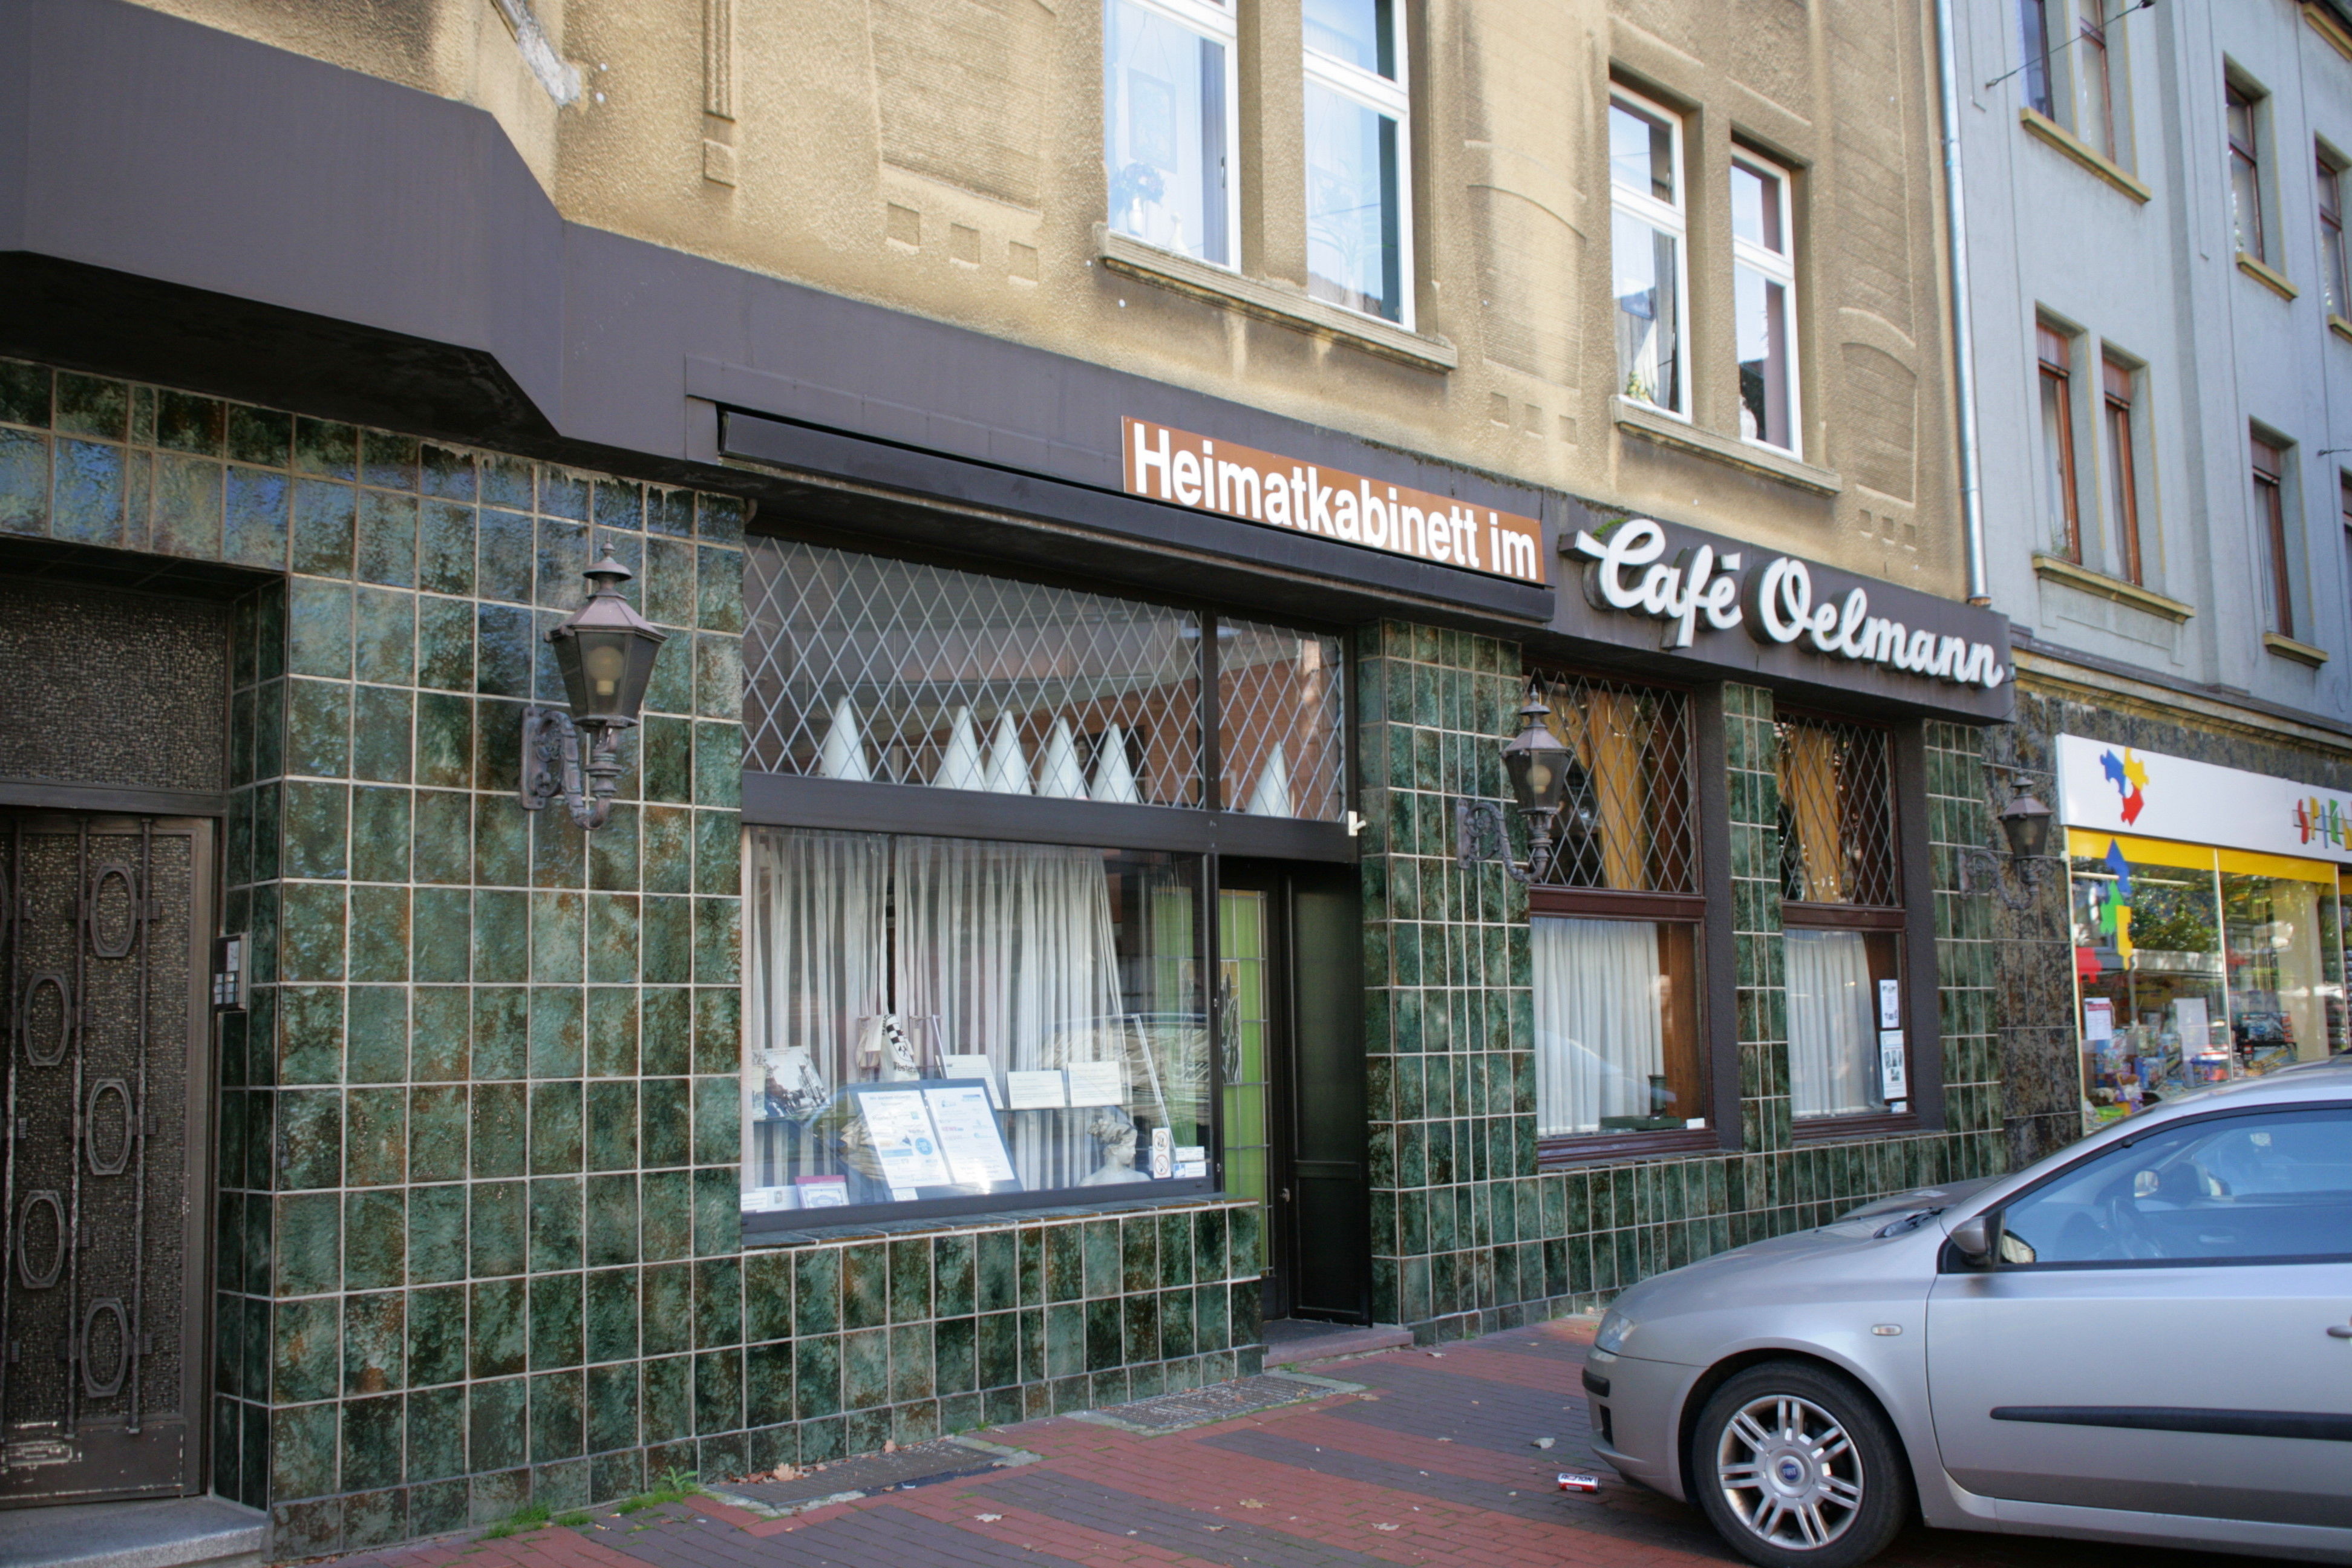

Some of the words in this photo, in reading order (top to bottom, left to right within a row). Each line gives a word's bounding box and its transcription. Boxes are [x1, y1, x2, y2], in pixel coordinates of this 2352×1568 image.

[1133, 422, 1480, 568] Heimatkabinett
[1488, 512, 1538, 580] im
[1575, 518, 1743, 648] Café
[1758, 556, 2004, 689] Oelmann
[1783, 1467, 1797, 1477] FIAT
